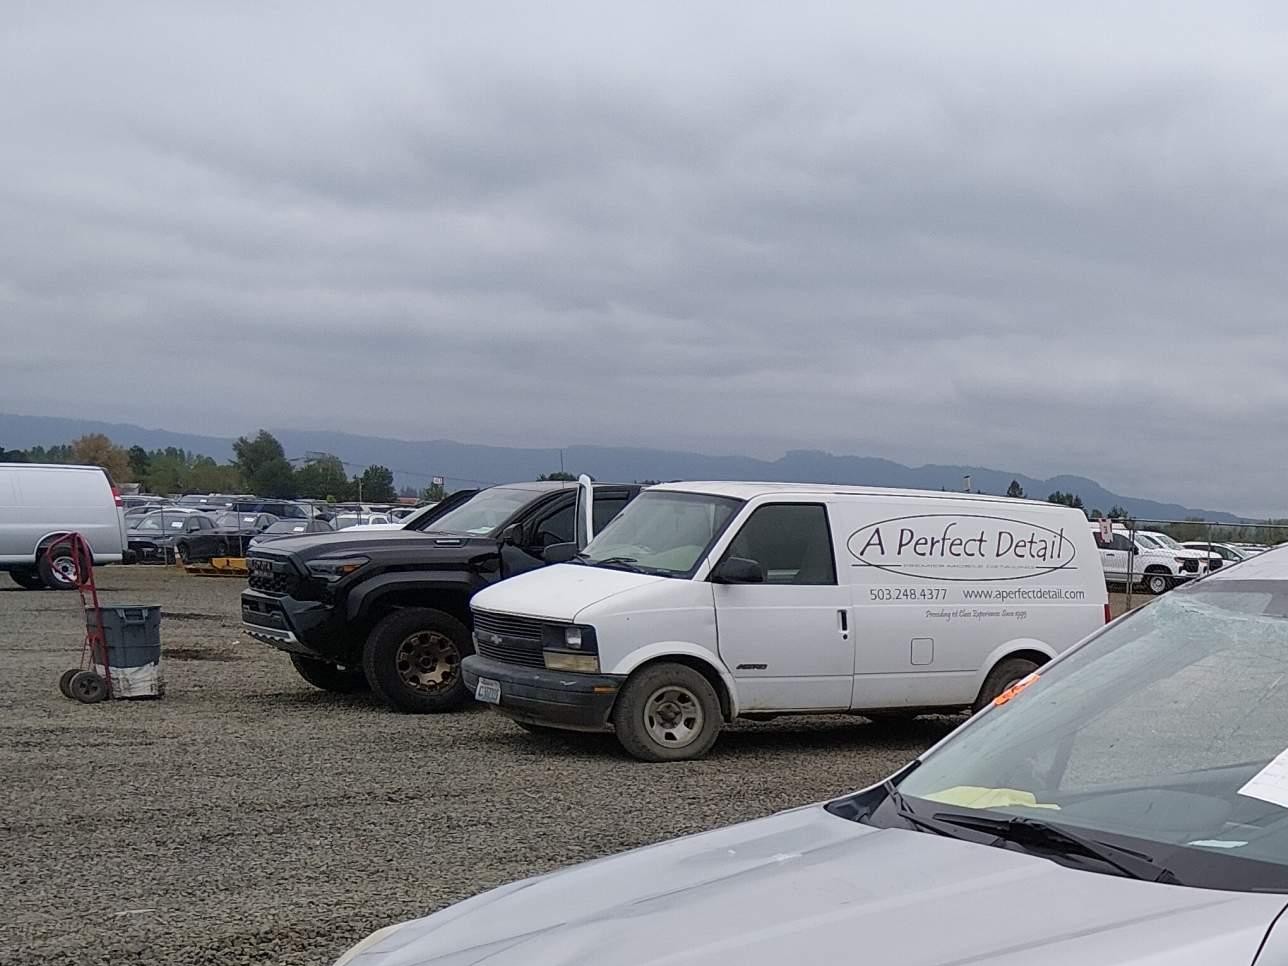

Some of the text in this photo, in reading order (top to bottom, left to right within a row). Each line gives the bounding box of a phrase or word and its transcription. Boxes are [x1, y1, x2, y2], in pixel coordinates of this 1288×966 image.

[859, 522, 1064, 562] A Perfect Detail
[869, 587, 1085, 602] 503.248.4377 www.aperfectdetail.com
